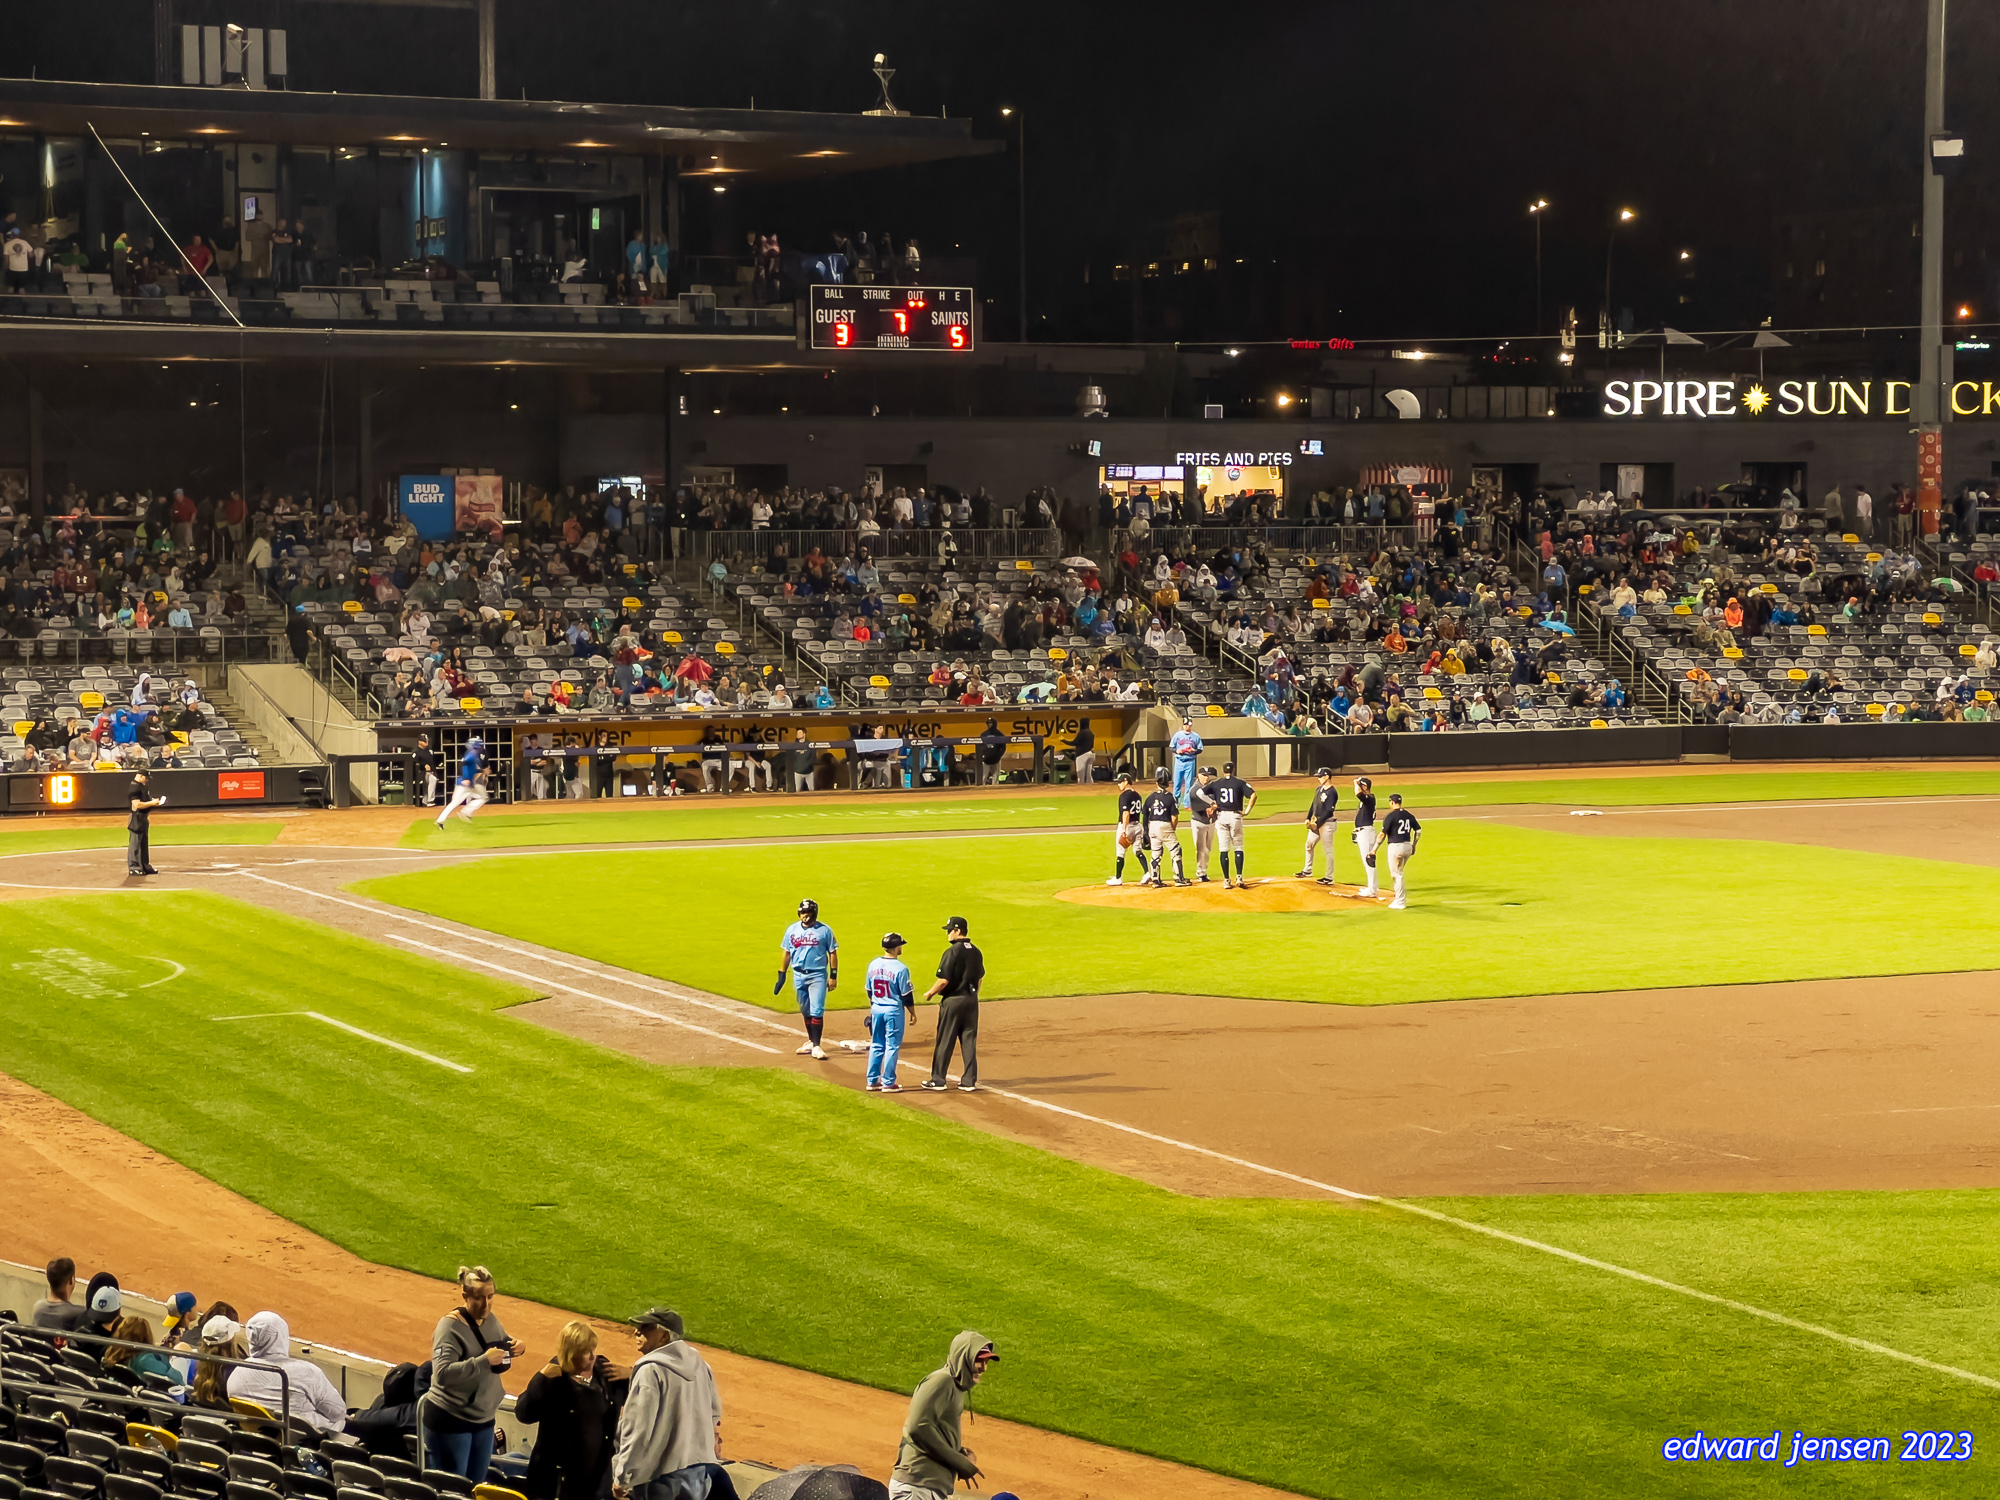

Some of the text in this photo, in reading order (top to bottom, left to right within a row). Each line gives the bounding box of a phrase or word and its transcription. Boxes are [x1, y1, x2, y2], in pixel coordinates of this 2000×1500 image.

[825, 289, 960, 301] BALL STRIKE OUT H E
[816, 309, 856, 323] GUEST
[894, 312, 907, 333] 7
[932, 311, 969, 326] SAINTS
[835, 324, 849, 346] 3
[877, 336, 910, 348] INNING
[950, 326, 964, 347] 5
[1603, 380, 2000, 417] SPIRE SUN DCK
[1176, 452, 1293, 466] FRIES AND PIES
[413, 483, 440, 494] BUD
[408, 493, 445, 503] LIGHT
[1010, 715, 1079, 738] stryke
[51, 775, 74, 804] 18
[1219, 788, 1234, 803] 31
[1130, 799, 1141, 815] 29
[1397, 819, 1411, 834] 24
[874, 979, 892, 999] 51
